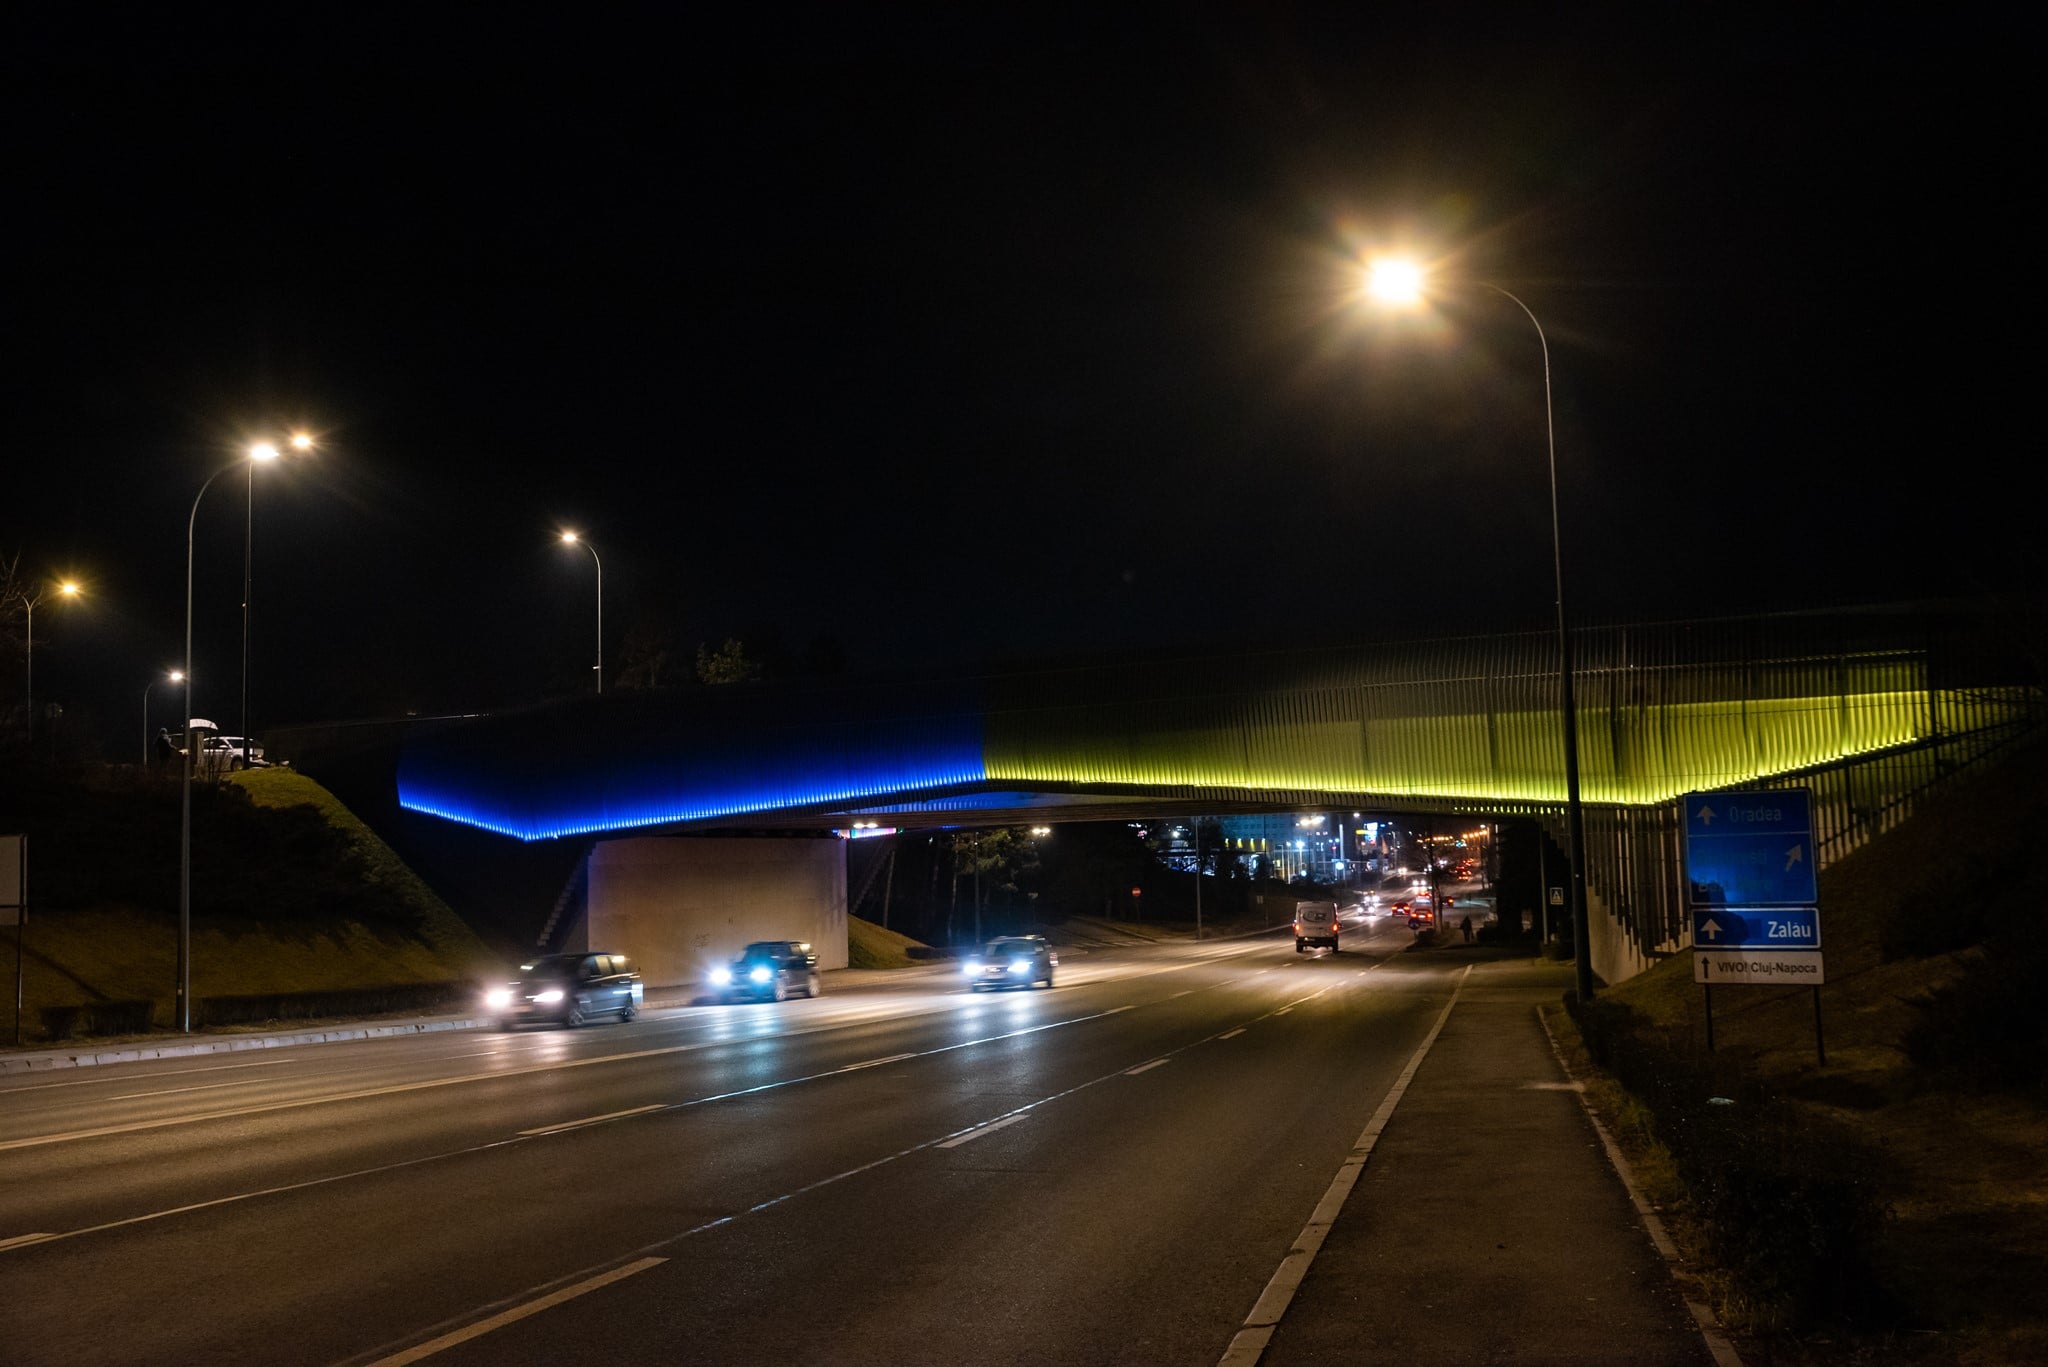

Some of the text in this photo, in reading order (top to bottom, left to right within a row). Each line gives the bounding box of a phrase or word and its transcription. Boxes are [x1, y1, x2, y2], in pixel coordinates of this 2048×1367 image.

[1730, 805, 1782, 822] Oradea
[1717, 962, 1817, 975] VIVO! Cluj-Napoca
